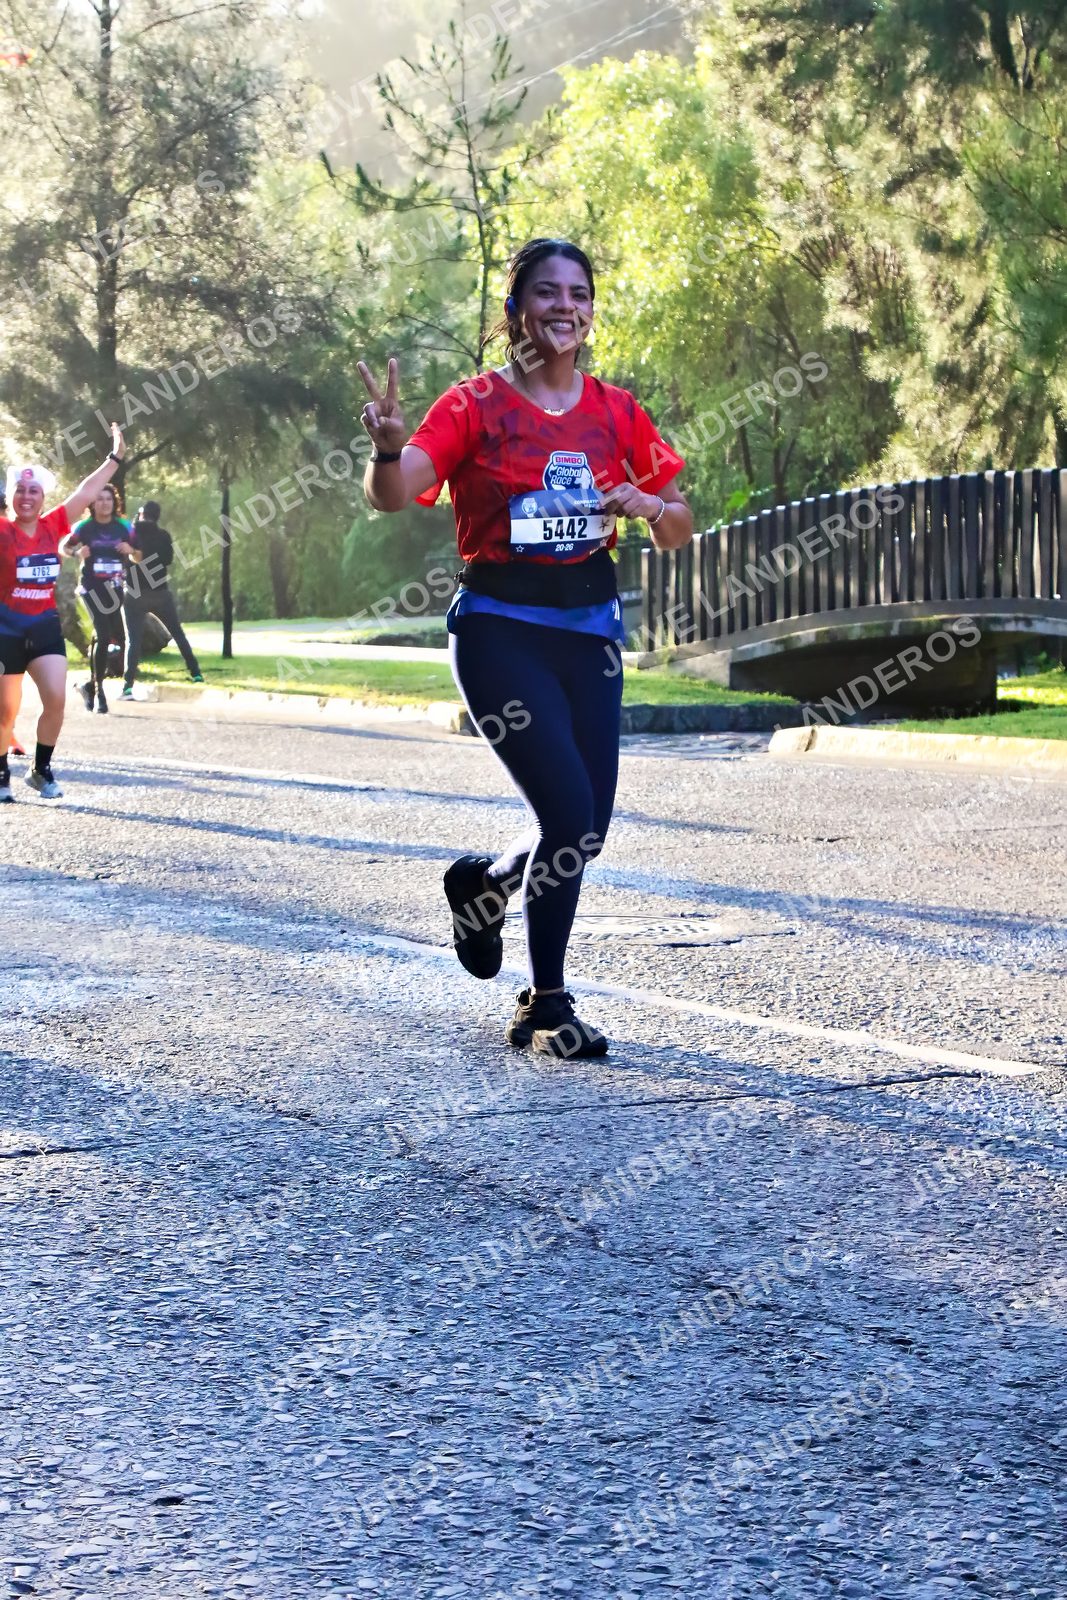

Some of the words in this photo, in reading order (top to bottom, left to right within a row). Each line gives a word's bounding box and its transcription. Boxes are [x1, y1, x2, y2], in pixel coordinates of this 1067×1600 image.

[555, 456, 582, 464] BIMBO
[556, 467, 582, 477] Global
[551, 475, 572, 485] Race
[543, 517, 588, 541] 5442
[32, 566, 50, 576] 4762
